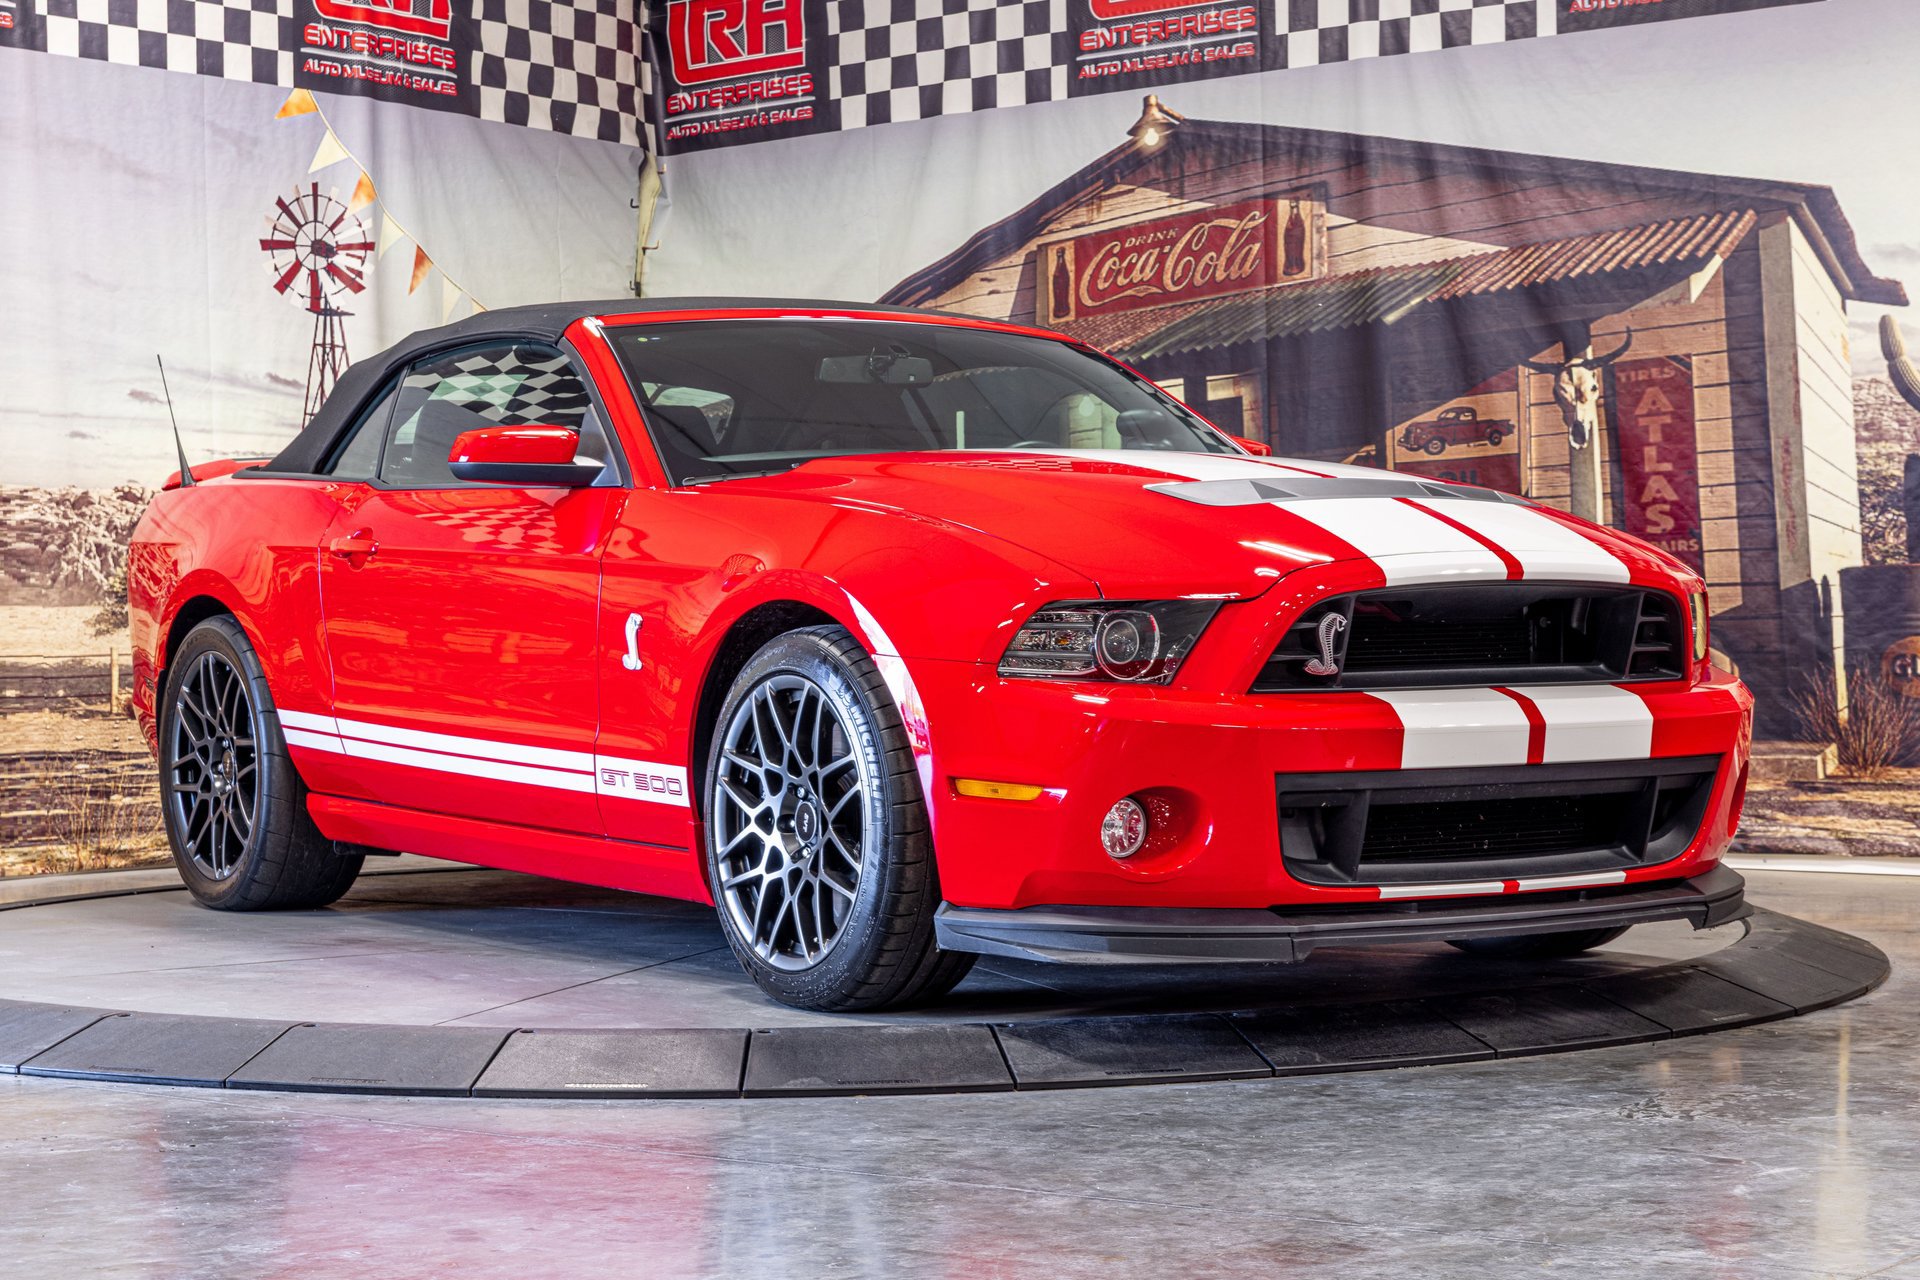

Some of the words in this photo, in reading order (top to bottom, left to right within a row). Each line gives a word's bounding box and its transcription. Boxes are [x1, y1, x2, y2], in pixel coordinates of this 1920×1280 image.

[303, 23, 457, 69] ENTERPRISES
[1079, 6, 1257, 51] ENTERPRISES
[303, 58, 341, 76] AUTO
[342, 63, 402, 87] MUSEUM
[403, 73, 411, 88] &
[413, 76, 458, 96] SALES
[1078, 60, 1121, 79] AUTO
[1122, 51, 1189, 73] MUSEUM
[1191, 49, 1203, 63] &
[1204, 42, 1256, 62] SALES
[666, 72, 815, 114] ENTERPRISES
[666, 124, 700, 140] AUTO
[701, 114, 758, 134] MUSEUM
[759, 111, 768, 126] &
[770, 106, 814, 123] SALES
[1079, 208, 1267, 307] Coca-Cola
[1125, 228, 1179, 249] DRINK
[1617, 366, 1676, 383] TIRES
[1634, 386, 1680, 534] ATLAS
[600, 768, 629, 788] GT
[633, 772, 682, 796] 500
[851, 704, 886, 820] MICHELIN
